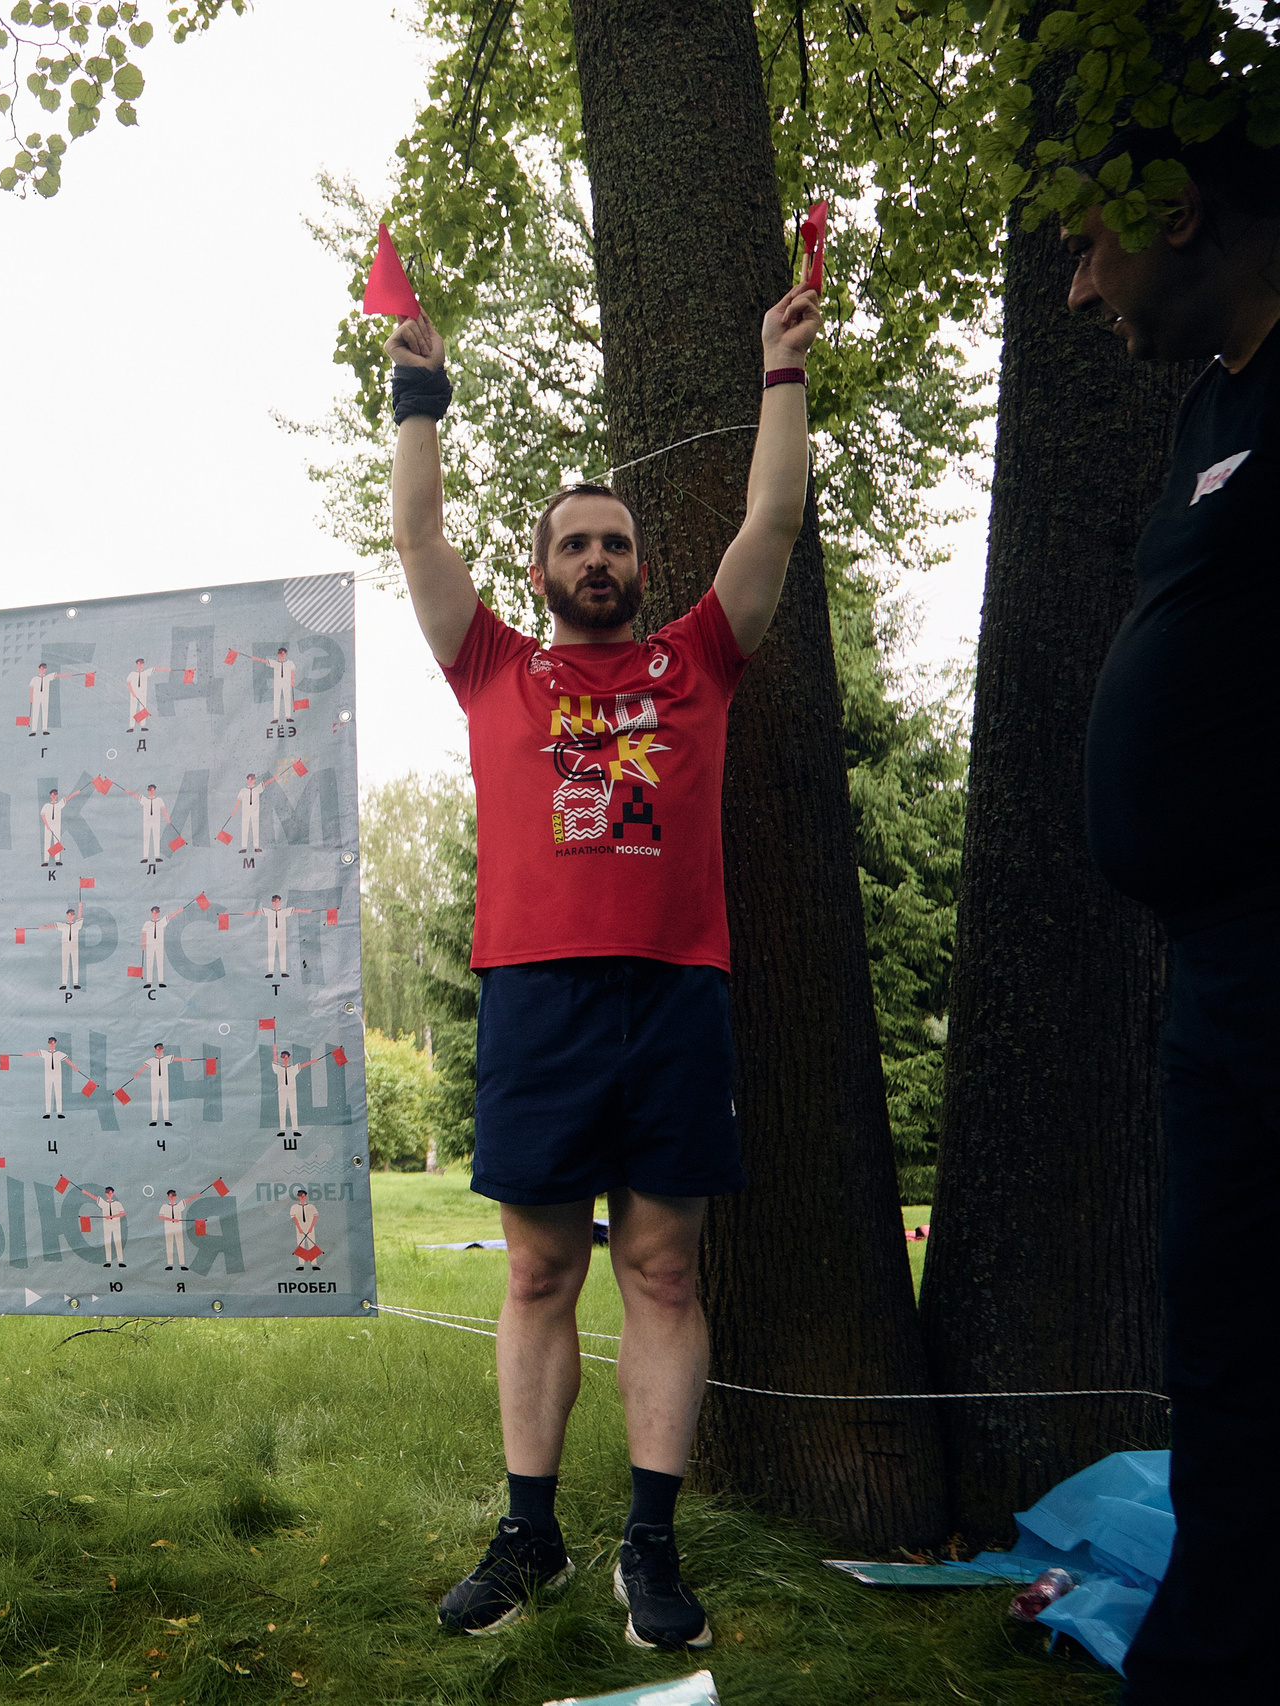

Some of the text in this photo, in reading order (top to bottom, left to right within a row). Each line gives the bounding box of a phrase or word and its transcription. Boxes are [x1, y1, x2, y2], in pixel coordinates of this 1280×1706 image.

[136, 738, 147, 753] Д
[41, 747, 48, 759] Г
[552, 813, 564, 844] 2022
[555, 845, 661, 858] MARATHON MOSCOW
[243, 857, 255, 869] М
[48, 870, 56, 882] К
[146, 864, 157, 876] Л
[147, 989, 158, 1002] С
[271, 984, 281, 996] Т
[65, 992, 73, 1004] Р
[47, 1140, 58, 1155] Ц
[156, 1139, 166, 1152] Ч
[283, 1138, 298, 1151] Ш
[255, 1181, 356, 1203] ПРОБЕЛ
[109, 1281, 124, 1293] Ю
[176, 1282, 186, 1293] Я
[277, 1281, 337, 1294] ПРОБЕЛ
